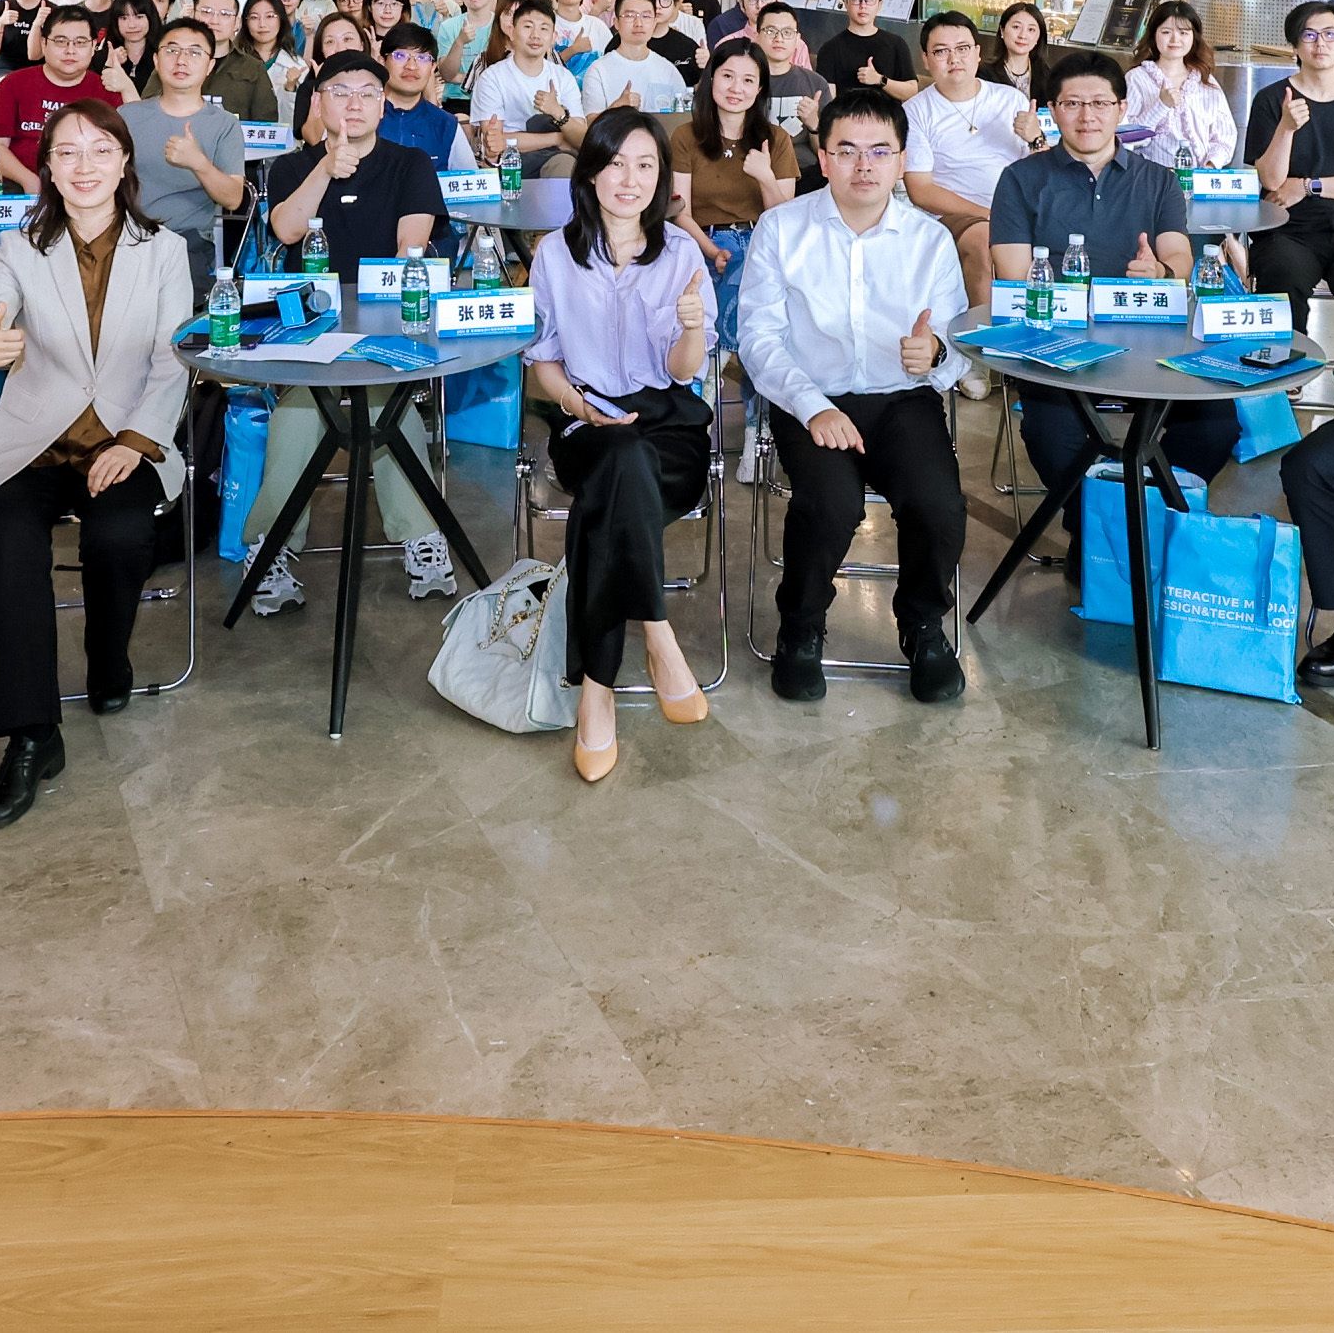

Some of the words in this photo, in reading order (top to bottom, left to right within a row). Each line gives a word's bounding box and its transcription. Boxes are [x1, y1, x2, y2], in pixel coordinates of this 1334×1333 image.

[448, 178, 488, 193] 倪士光
[1112, 291, 1169, 308] 董宇涵
[457, 302, 516, 322] 张晓芸
[1221, 307, 1275, 326] 王力哲
[1165, 585, 1240, 608] TERACTIVE
[1243, 598, 1288, 614] MDIA
